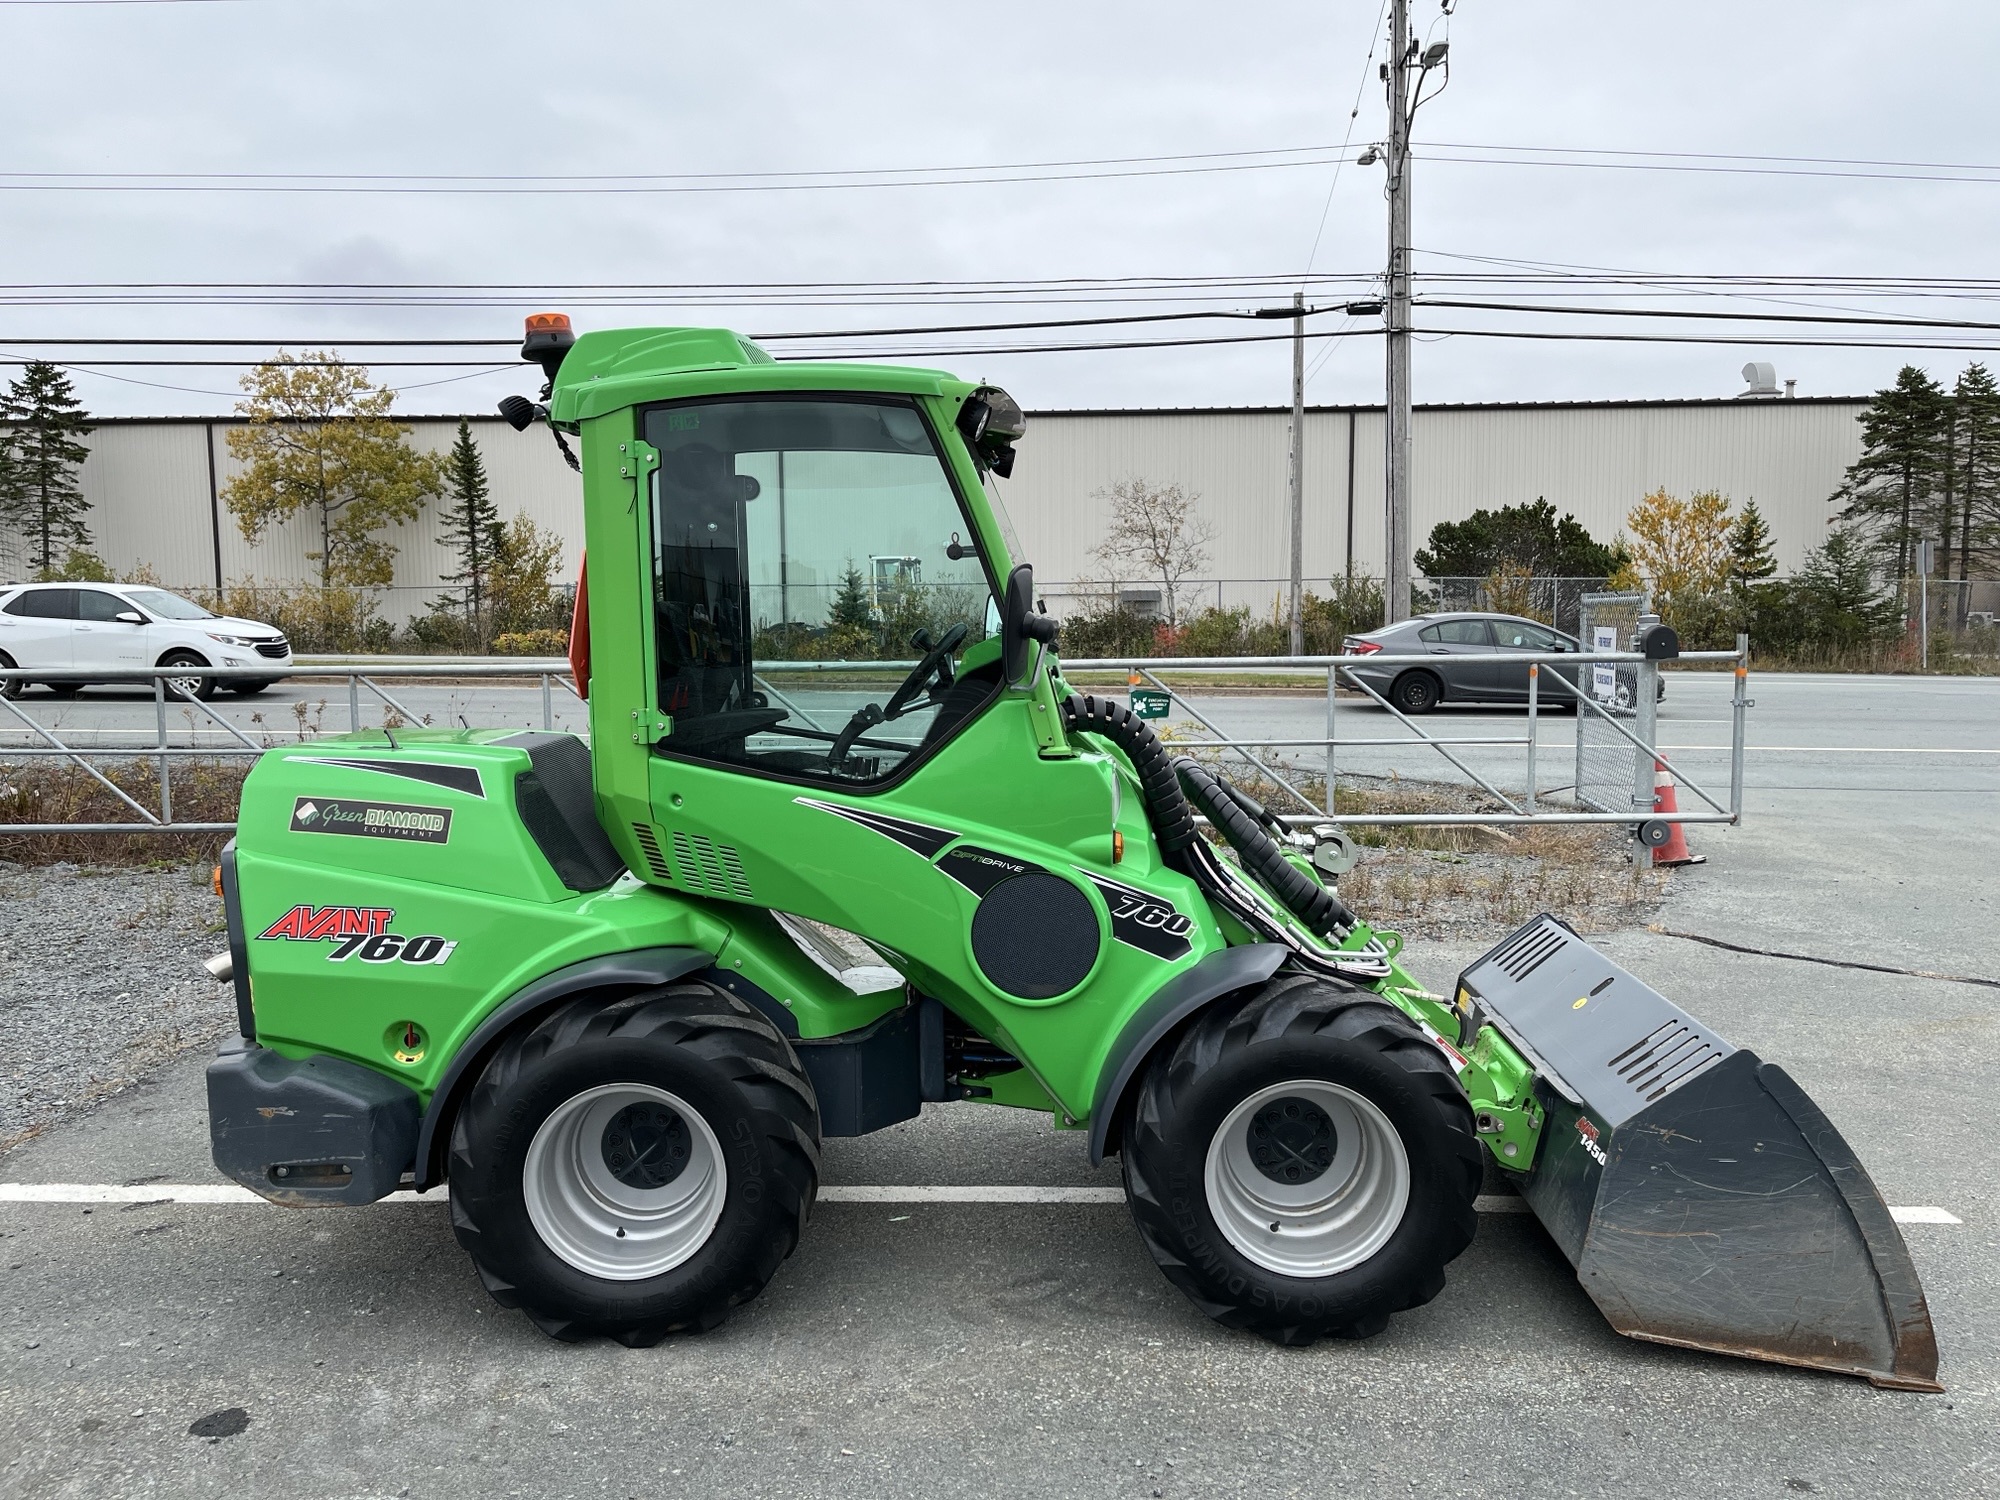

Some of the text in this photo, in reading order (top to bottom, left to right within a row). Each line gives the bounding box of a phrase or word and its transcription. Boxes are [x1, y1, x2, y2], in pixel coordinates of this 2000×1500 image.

[322, 803, 445, 832] Green DIAMOND
[363, 826, 433, 838] EQUIPMENT
[949, 849, 1025, 873] OPTIDRIVE
[325, 933, 460, 966] 760i
[1580, 1133, 1607, 1166] 1450
[1169, 1197, 1249, 1299] DUMPER
